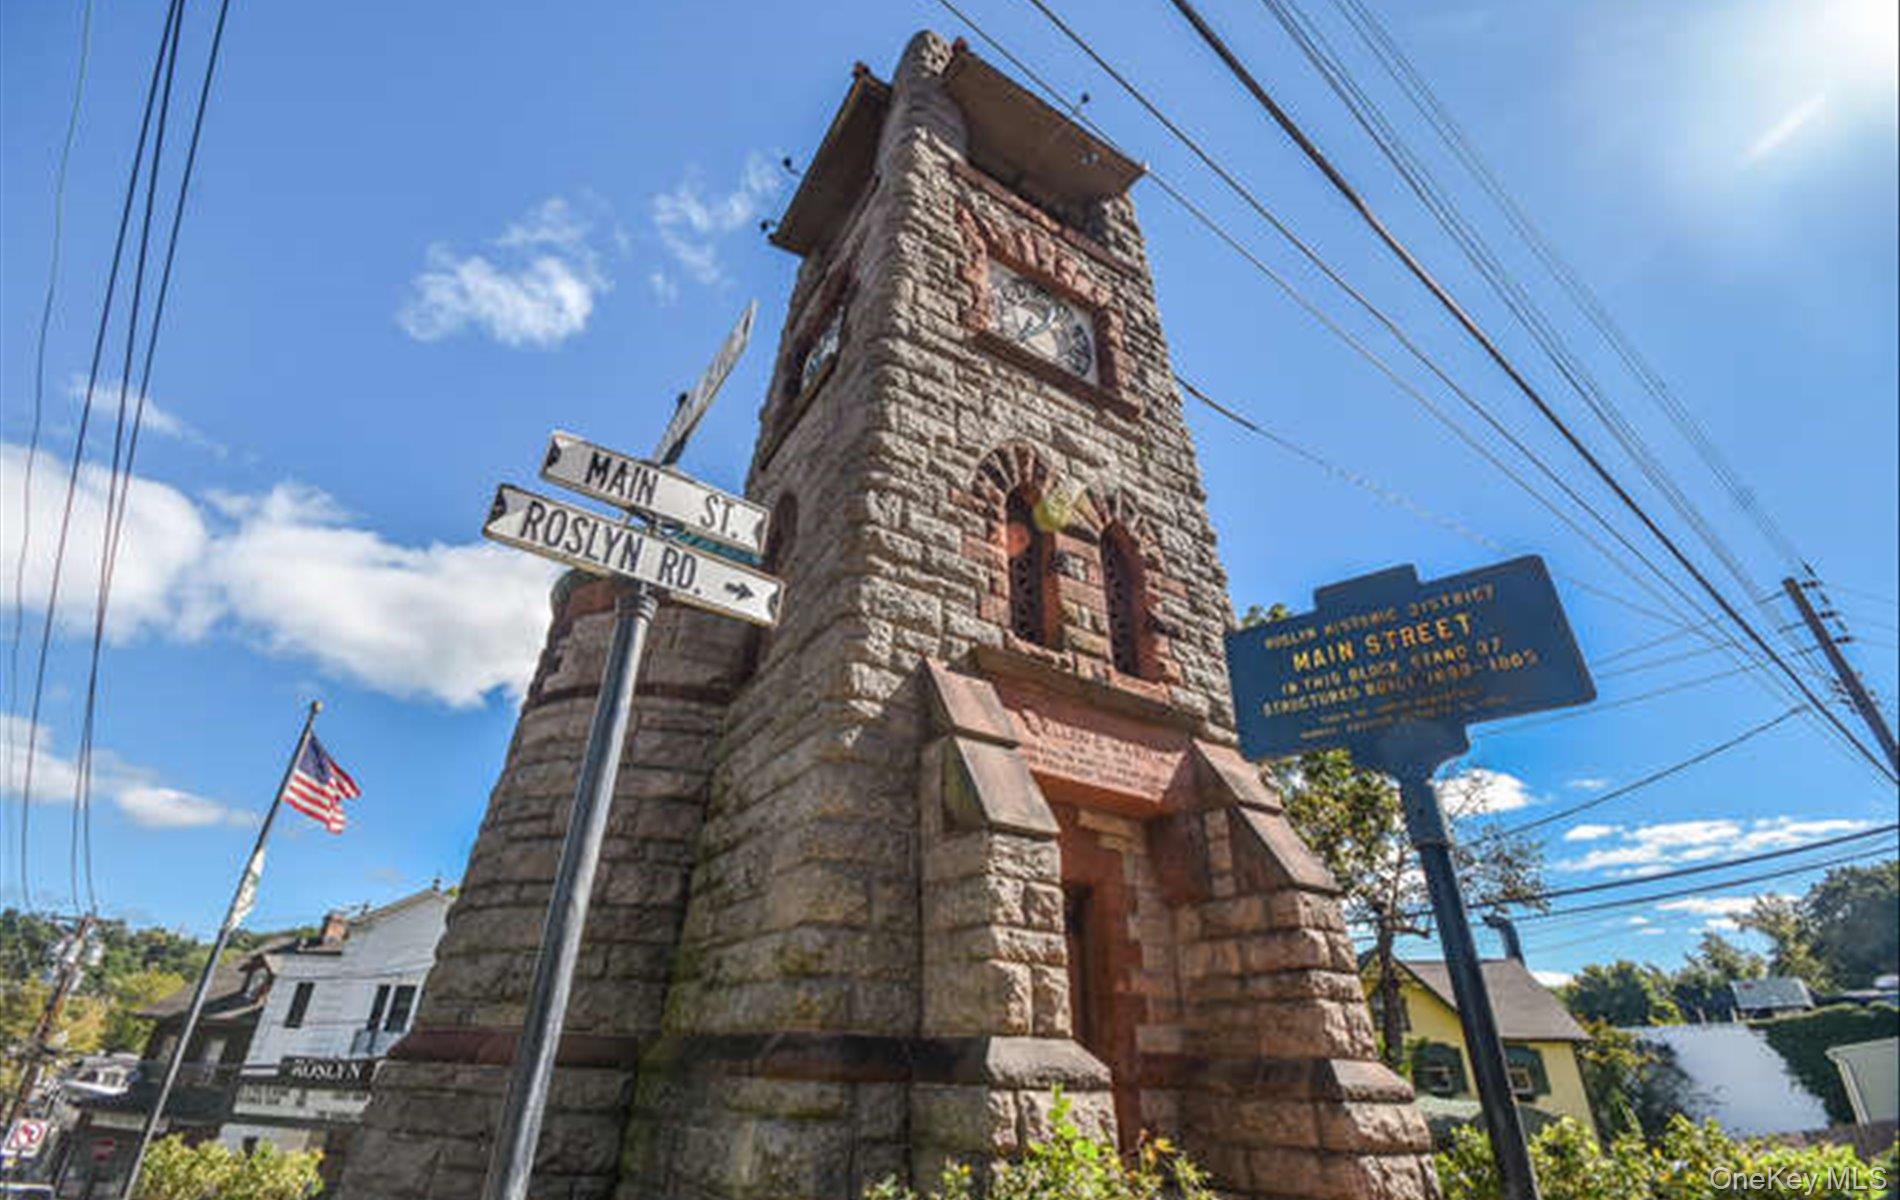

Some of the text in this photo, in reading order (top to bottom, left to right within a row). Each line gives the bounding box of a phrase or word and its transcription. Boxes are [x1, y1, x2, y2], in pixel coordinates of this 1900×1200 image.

[585, 451, 738, 539] MAIN ST.
[519, 501, 702, 595] ROSLYN RD.
[1323, 607, 1397, 637] HISTORIC
[1407, 583, 1494, 618] DISTRICT
[1292, 613, 1472, 672] MAIN STREET
[1262, 685, 1359, 719] STRUCTURES
[1365, 672, 1415, 697] BUILT
[1281, 681, 1298, 697] IN
[1304, 671, 1341, 691] THIS
[1348, 660, 1399, 683] BLOCK
[1410, 643, 1467, 669] STAND
[291, 1058, 362, 1080] ROSLYN
